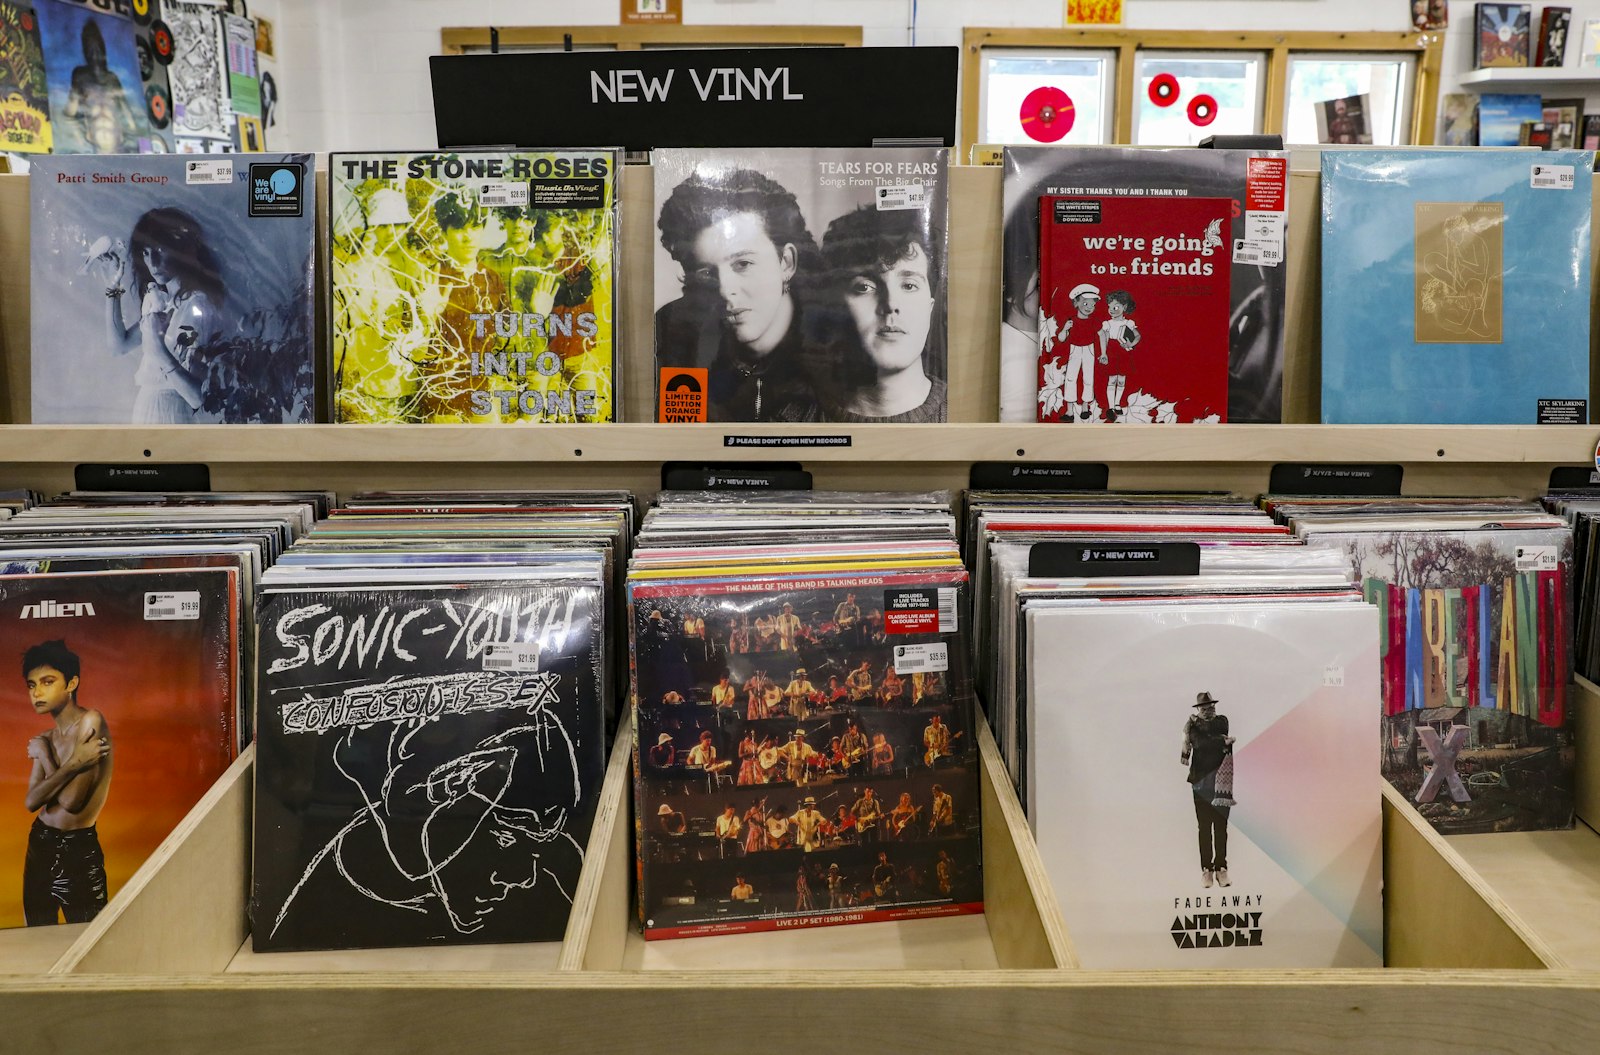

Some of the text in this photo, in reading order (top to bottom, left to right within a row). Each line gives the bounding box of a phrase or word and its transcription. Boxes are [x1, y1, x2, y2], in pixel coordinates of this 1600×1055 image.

[591, 67, 803, 102] NEW VINYL
[217, 168, 232, 176] $37.99
[342, 158, 608, 179] THE STONE ROSES
[819, 162, 938, 175] TEARS FOR FEARS
[57, 173, 169, 186] Patti Smith Group
[254, 179, 269, 187] We
[820, 176, 846, 188] Songs
[849, 177, 874, 186] From
[875, 177, 892, 186] The
[912, 177, 938, 187] Chair
[254, 193, 276, 203] vinyl
[510, 190, 526, 199] $28.99
[1086, 187, 1112, 195] THANKS
[1114, 188, 1128, 196] YOU
[1129, 188, 1144, 196] AND
[1145, 188, 1149, 196] I
[1150, 188, 1173, 196] THANK
[1174, 188, 1188, 196] YOU
[1083, 233, 1214, 256] we're going
[1263, 250, 1278, 259] $29.99
[1090, 257, 1214, 276] to be friends
[470, 312, 598, 338] TURNS
[471, 352, 562, 376] INTO
[470, 390, 597, 416] STONE
[665, 400, 701, 408] EDITION
[664, 415, 701, 423] VINYL
[778, 582, 794, 590] THIS
[826, 578, 857, 587] TALKING
[858, 577, 884, 585] HEADS
[182, 602, 198, 611] $19.99
[518, 654, 536, 663] $21.99
[930, 652, 946, 661] $35.99
[284, 676, 561, 731] CONFUSION IS SEX
[1415, 728, 1472, 804] X
[1174, 895, 1262, 909] FADE AWAY
[776, 920, 792, 928] LIVE
[800, 918, 808, 926] LP
[810, 917, 822, 925] SET
[824, 914, 864, 924] (1980-1981)
[1170, 912, 1263, 931] ANTHONY
